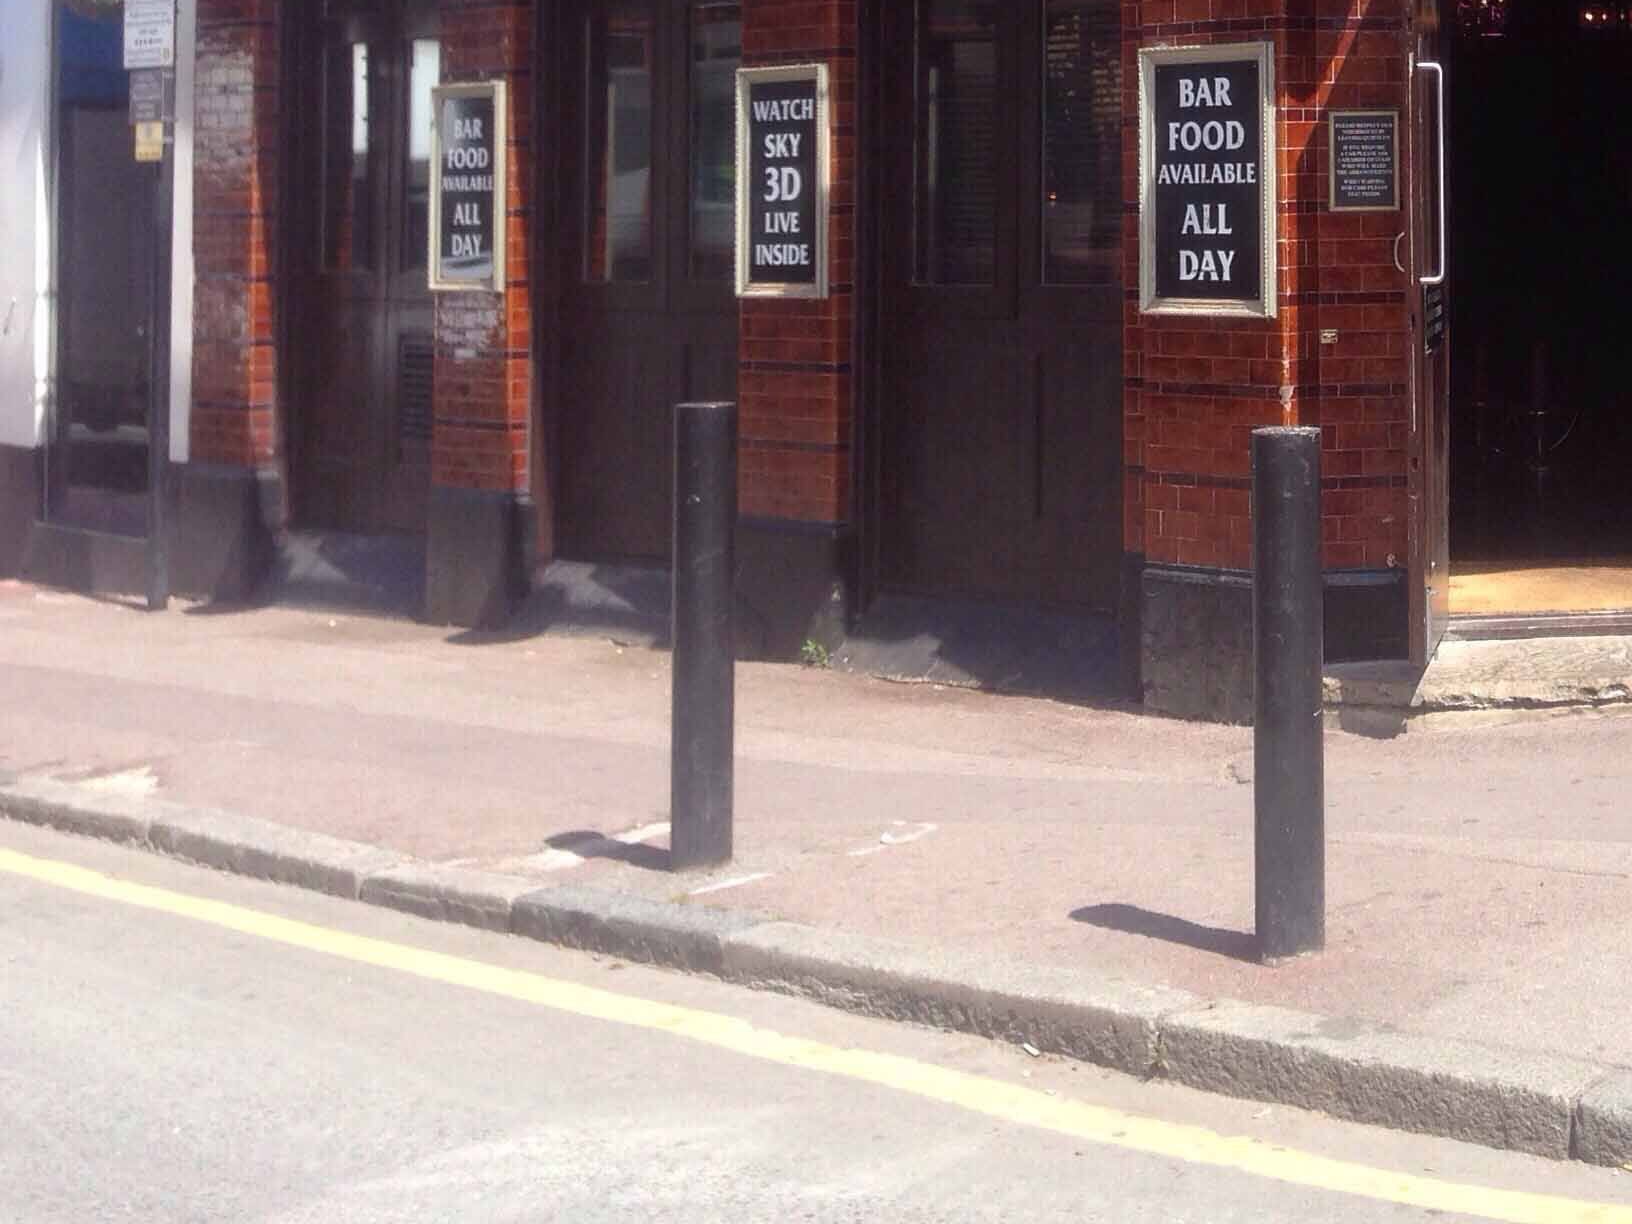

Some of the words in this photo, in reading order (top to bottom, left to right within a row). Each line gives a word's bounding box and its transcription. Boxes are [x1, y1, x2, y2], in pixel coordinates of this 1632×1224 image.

[1178, 77, 1232, 108] BAR
[753, 97, 814, 122] WATCH
[454, 118, 483, 140] BAR
[1168, 120, 1245, 152] FOOD
[447, 147, 488, 169] FOOD
[763, 133, 800, 159] SKY
[441, 174, 494, 192] AVAILABLE
[764, 167, 801, 202] 3D
[1157, 162, 1257, 185] AVAILABLE
[453, 203, 482, 226] ALL
[764, 211, 800, 234] LIVE
[1181, 204, 1232, 236] ALL
[451, 233, 483, 258] DAY
[754, 243, 810, 266] INSIDE
[1178, 249, 1236, 282] DAY
